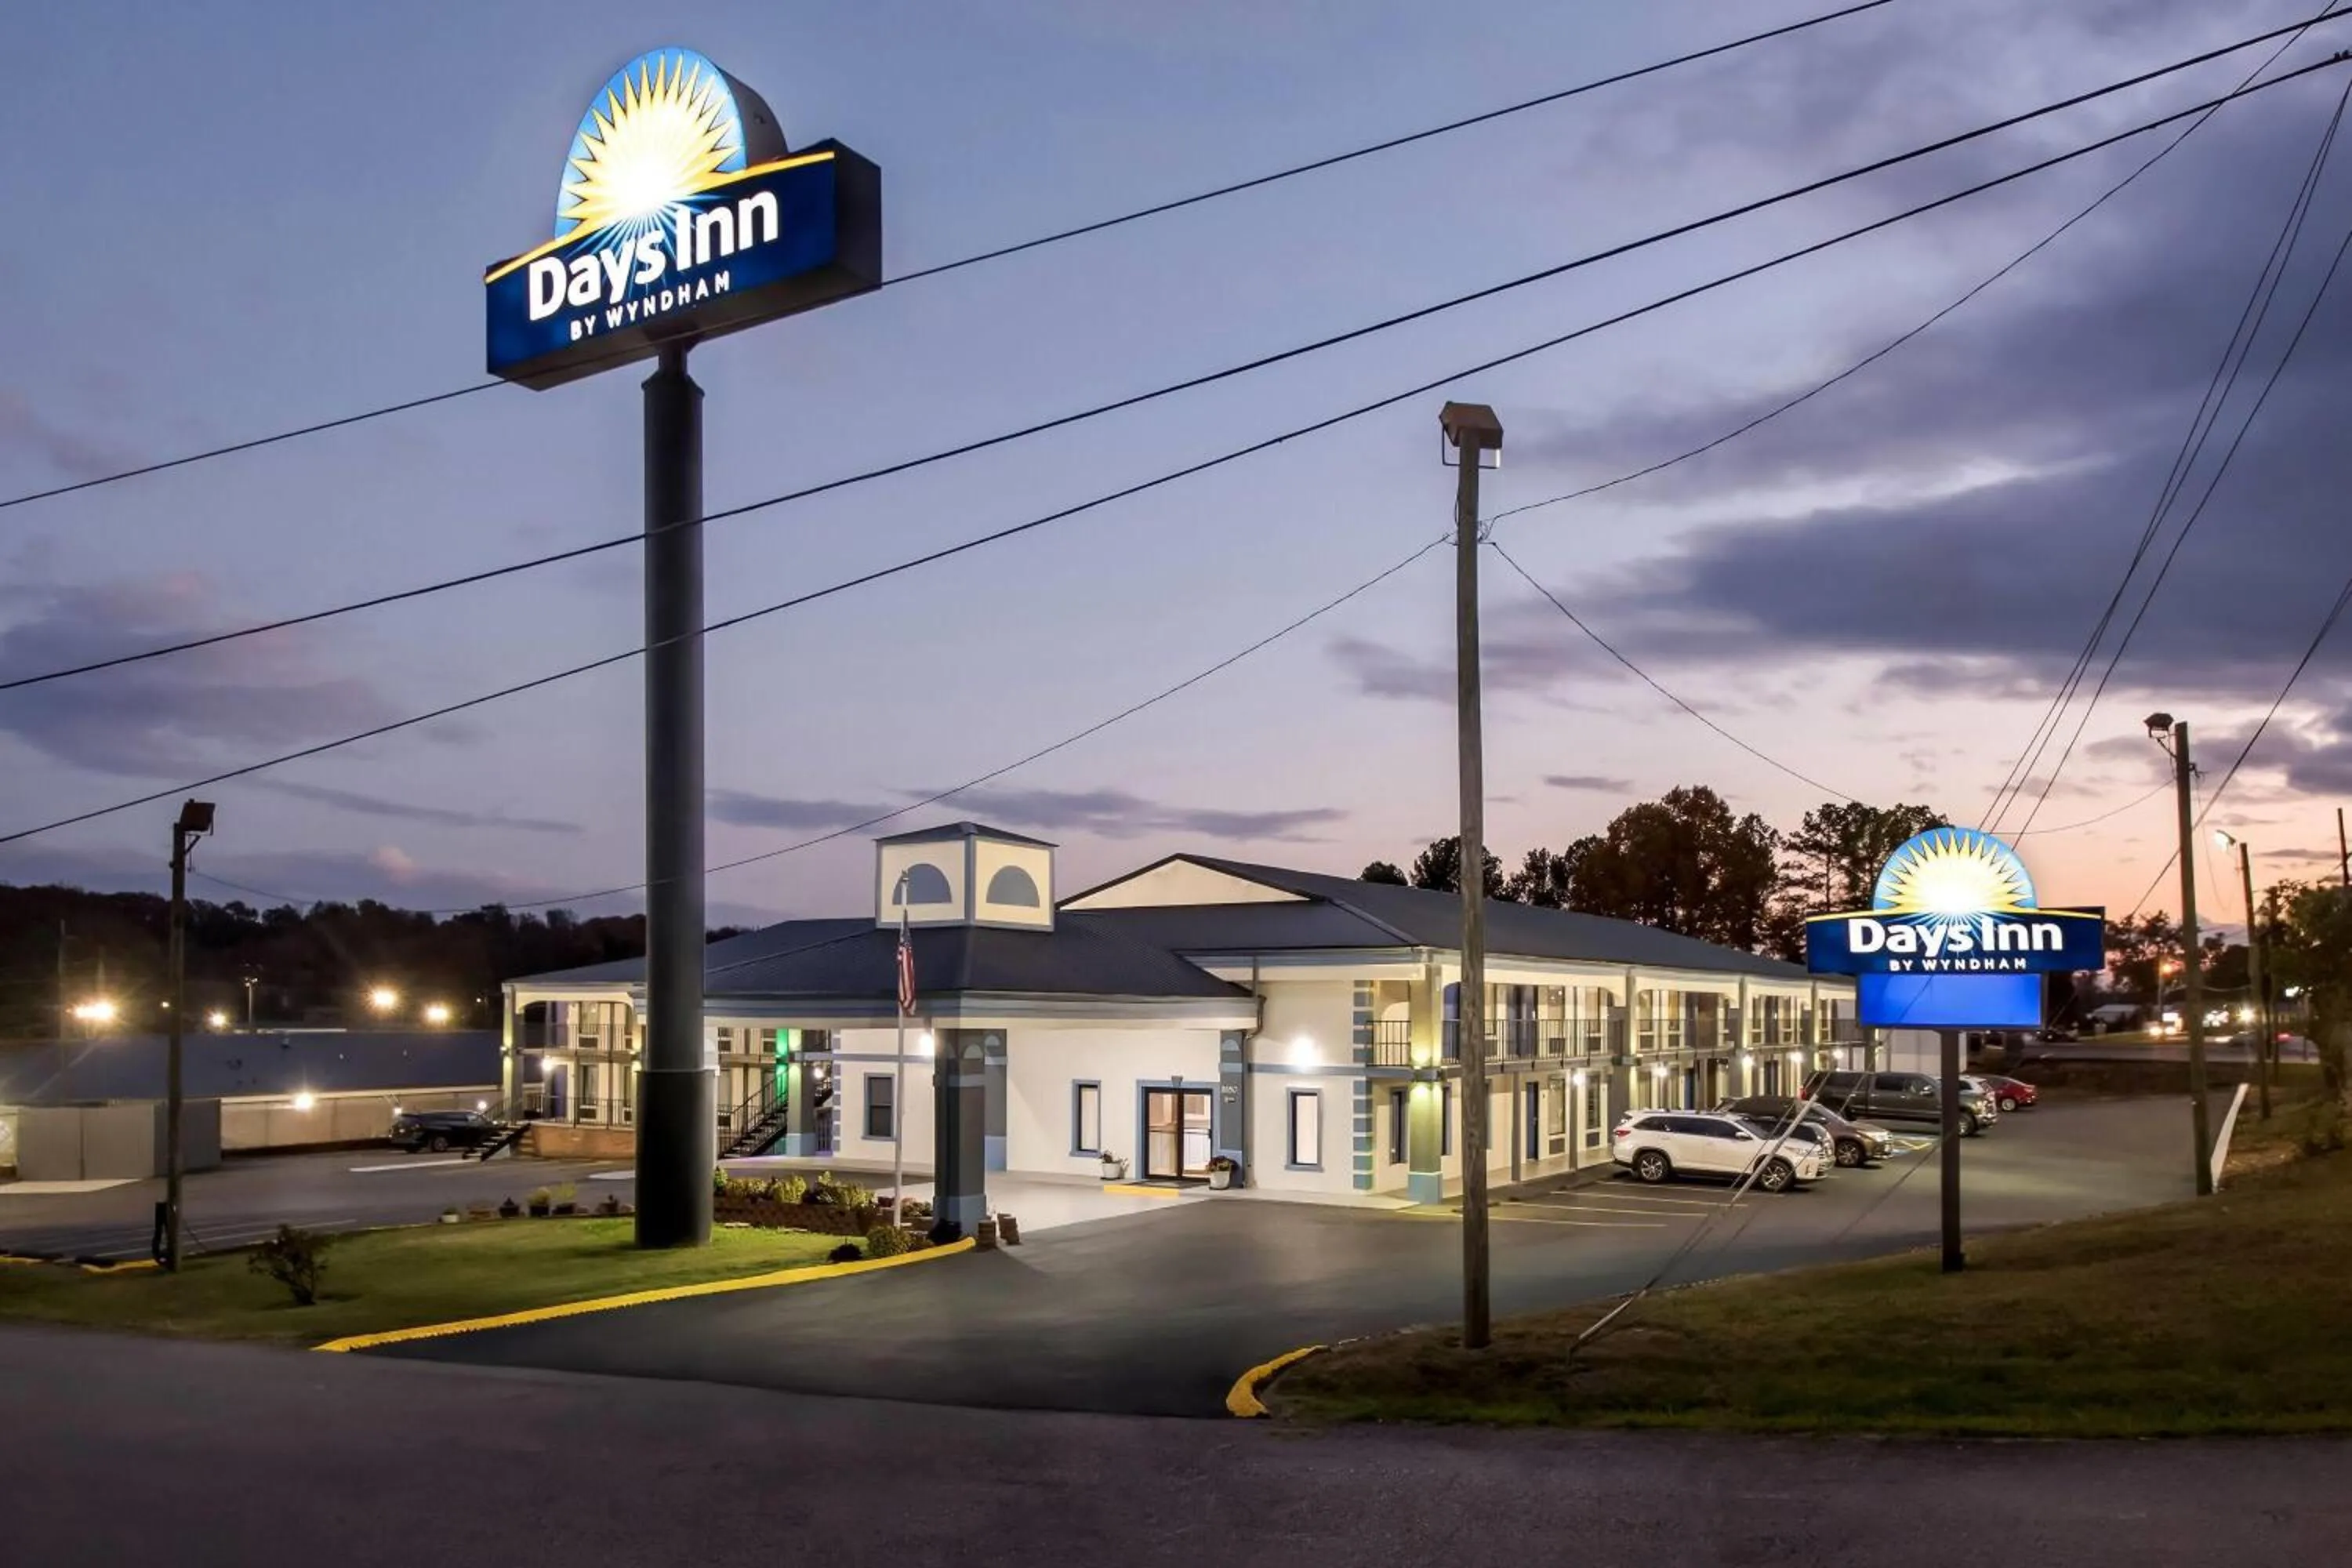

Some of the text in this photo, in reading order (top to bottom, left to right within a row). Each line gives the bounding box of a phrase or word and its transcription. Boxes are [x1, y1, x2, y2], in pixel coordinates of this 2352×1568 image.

[528, 191, 779, 321] Days Inn
[571, 270, 730, 341] BY WYNDHAM
[1848, 918, 2063, 957] Days Inn
[1889, 959, 2027, 972] BY WYNDHAM
